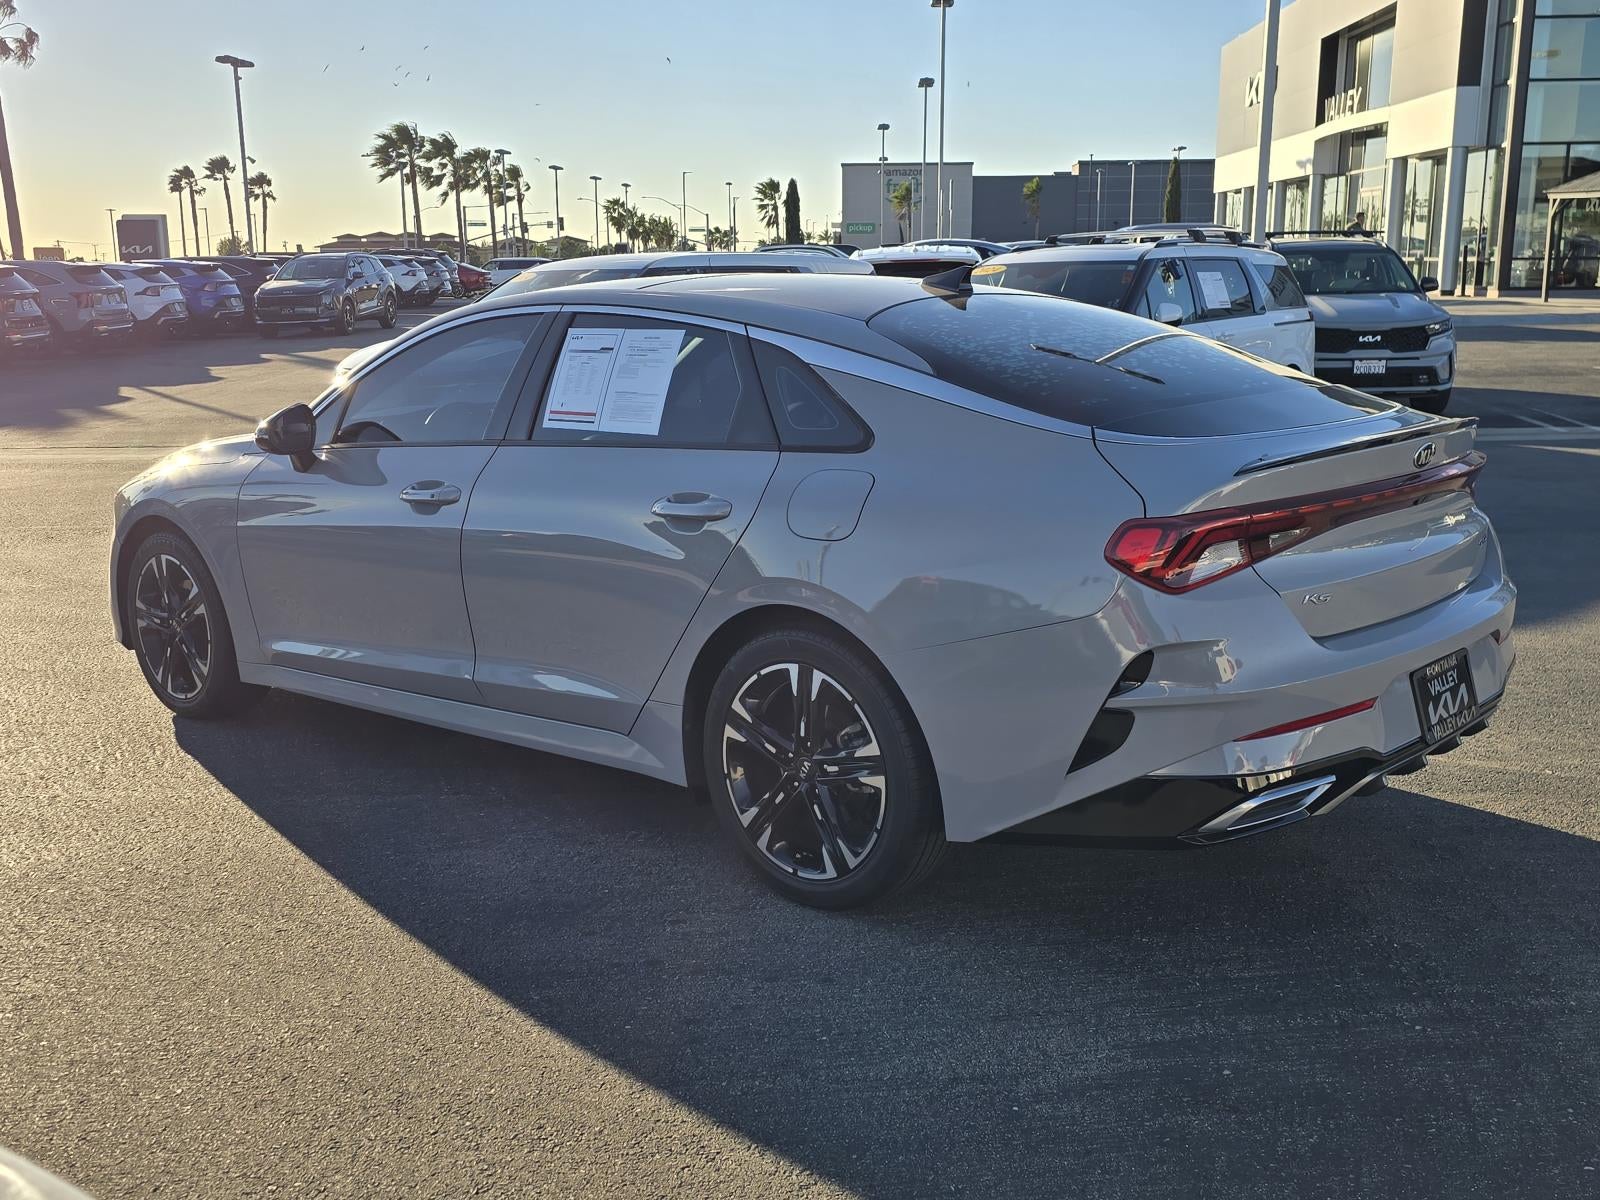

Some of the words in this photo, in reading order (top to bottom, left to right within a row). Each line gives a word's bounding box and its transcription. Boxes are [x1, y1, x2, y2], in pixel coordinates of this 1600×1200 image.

[1324, 85, 1362, 123] VALLEY
[848, 222, 874, 233] pickup
[121, 245, 153, 254] KIA
[1426, 654, 1458, 676] FONTANA
[1428, 669, 1458, 697] VALLEY
[1428, 682, 1469, 725] KIA
[1431, 717, 1457, 741] VALLEY
[1456, 705, 1476, 728] KIA
